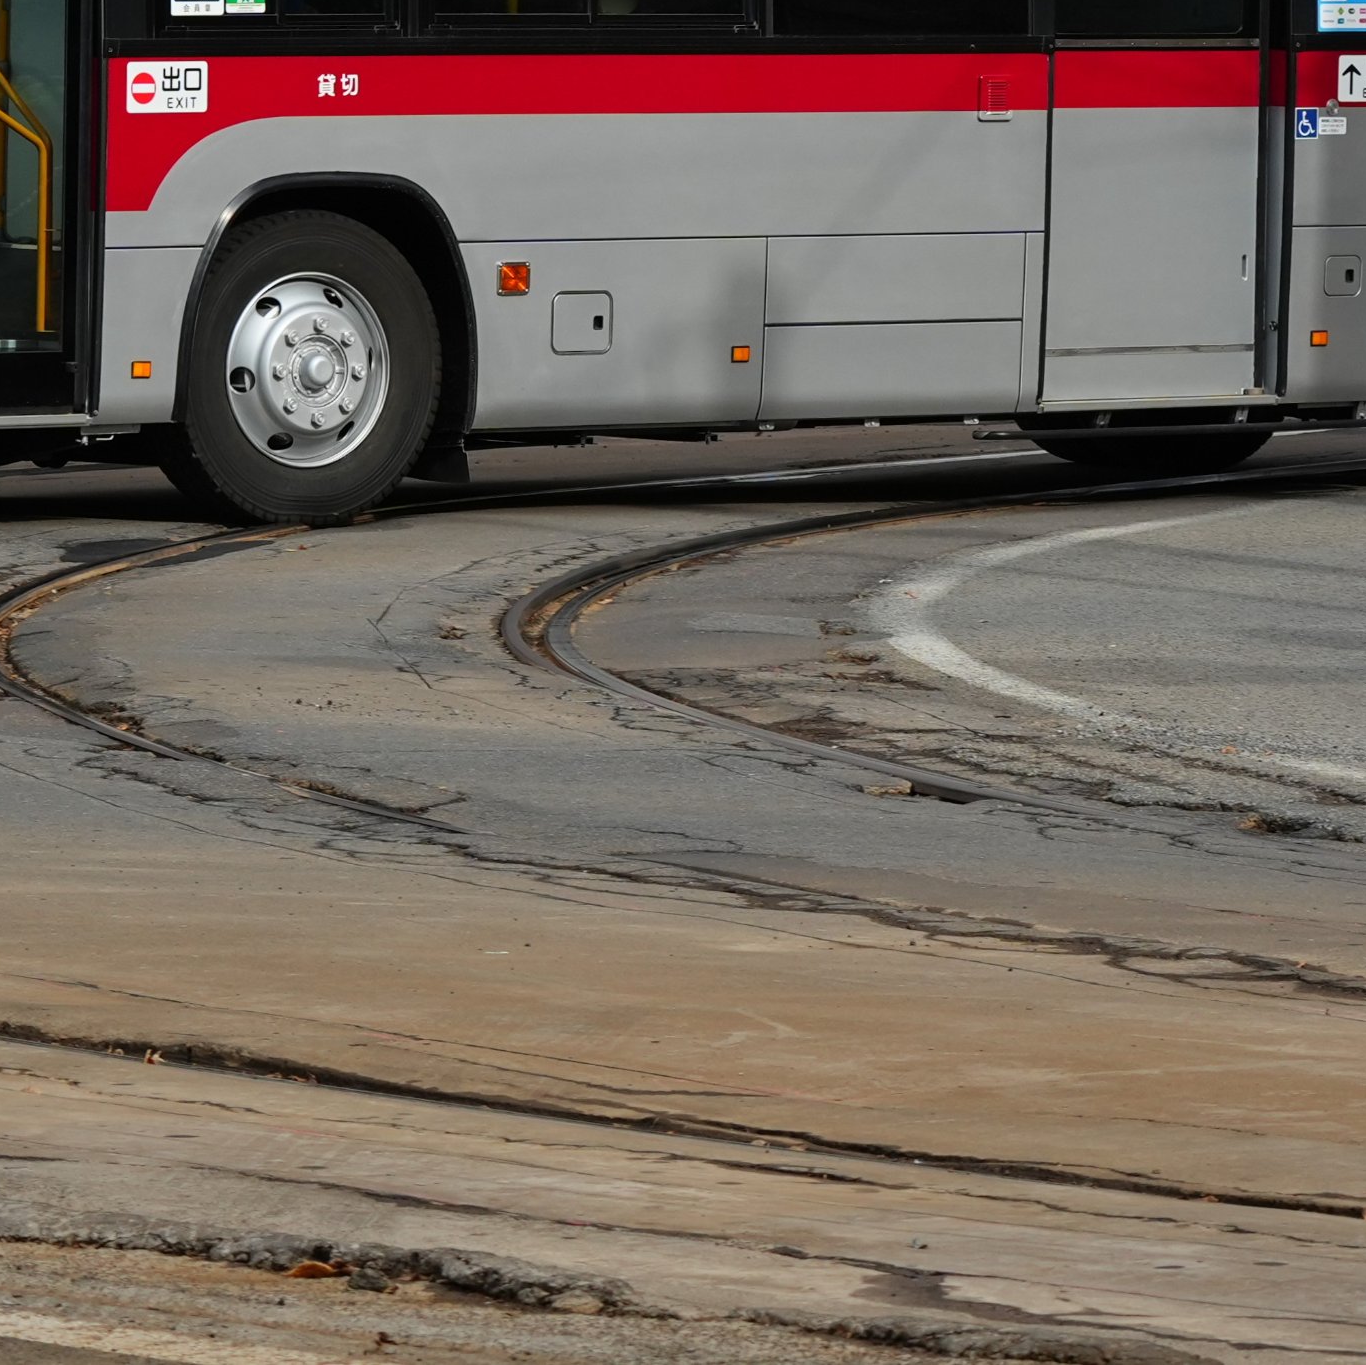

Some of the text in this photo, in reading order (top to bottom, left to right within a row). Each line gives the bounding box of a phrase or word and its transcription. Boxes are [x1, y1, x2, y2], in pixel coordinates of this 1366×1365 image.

[161, 66, 202, 92] 出口
[317, 73, 360, 98] 貸切
[166, 96, 198, 109] EXIT
